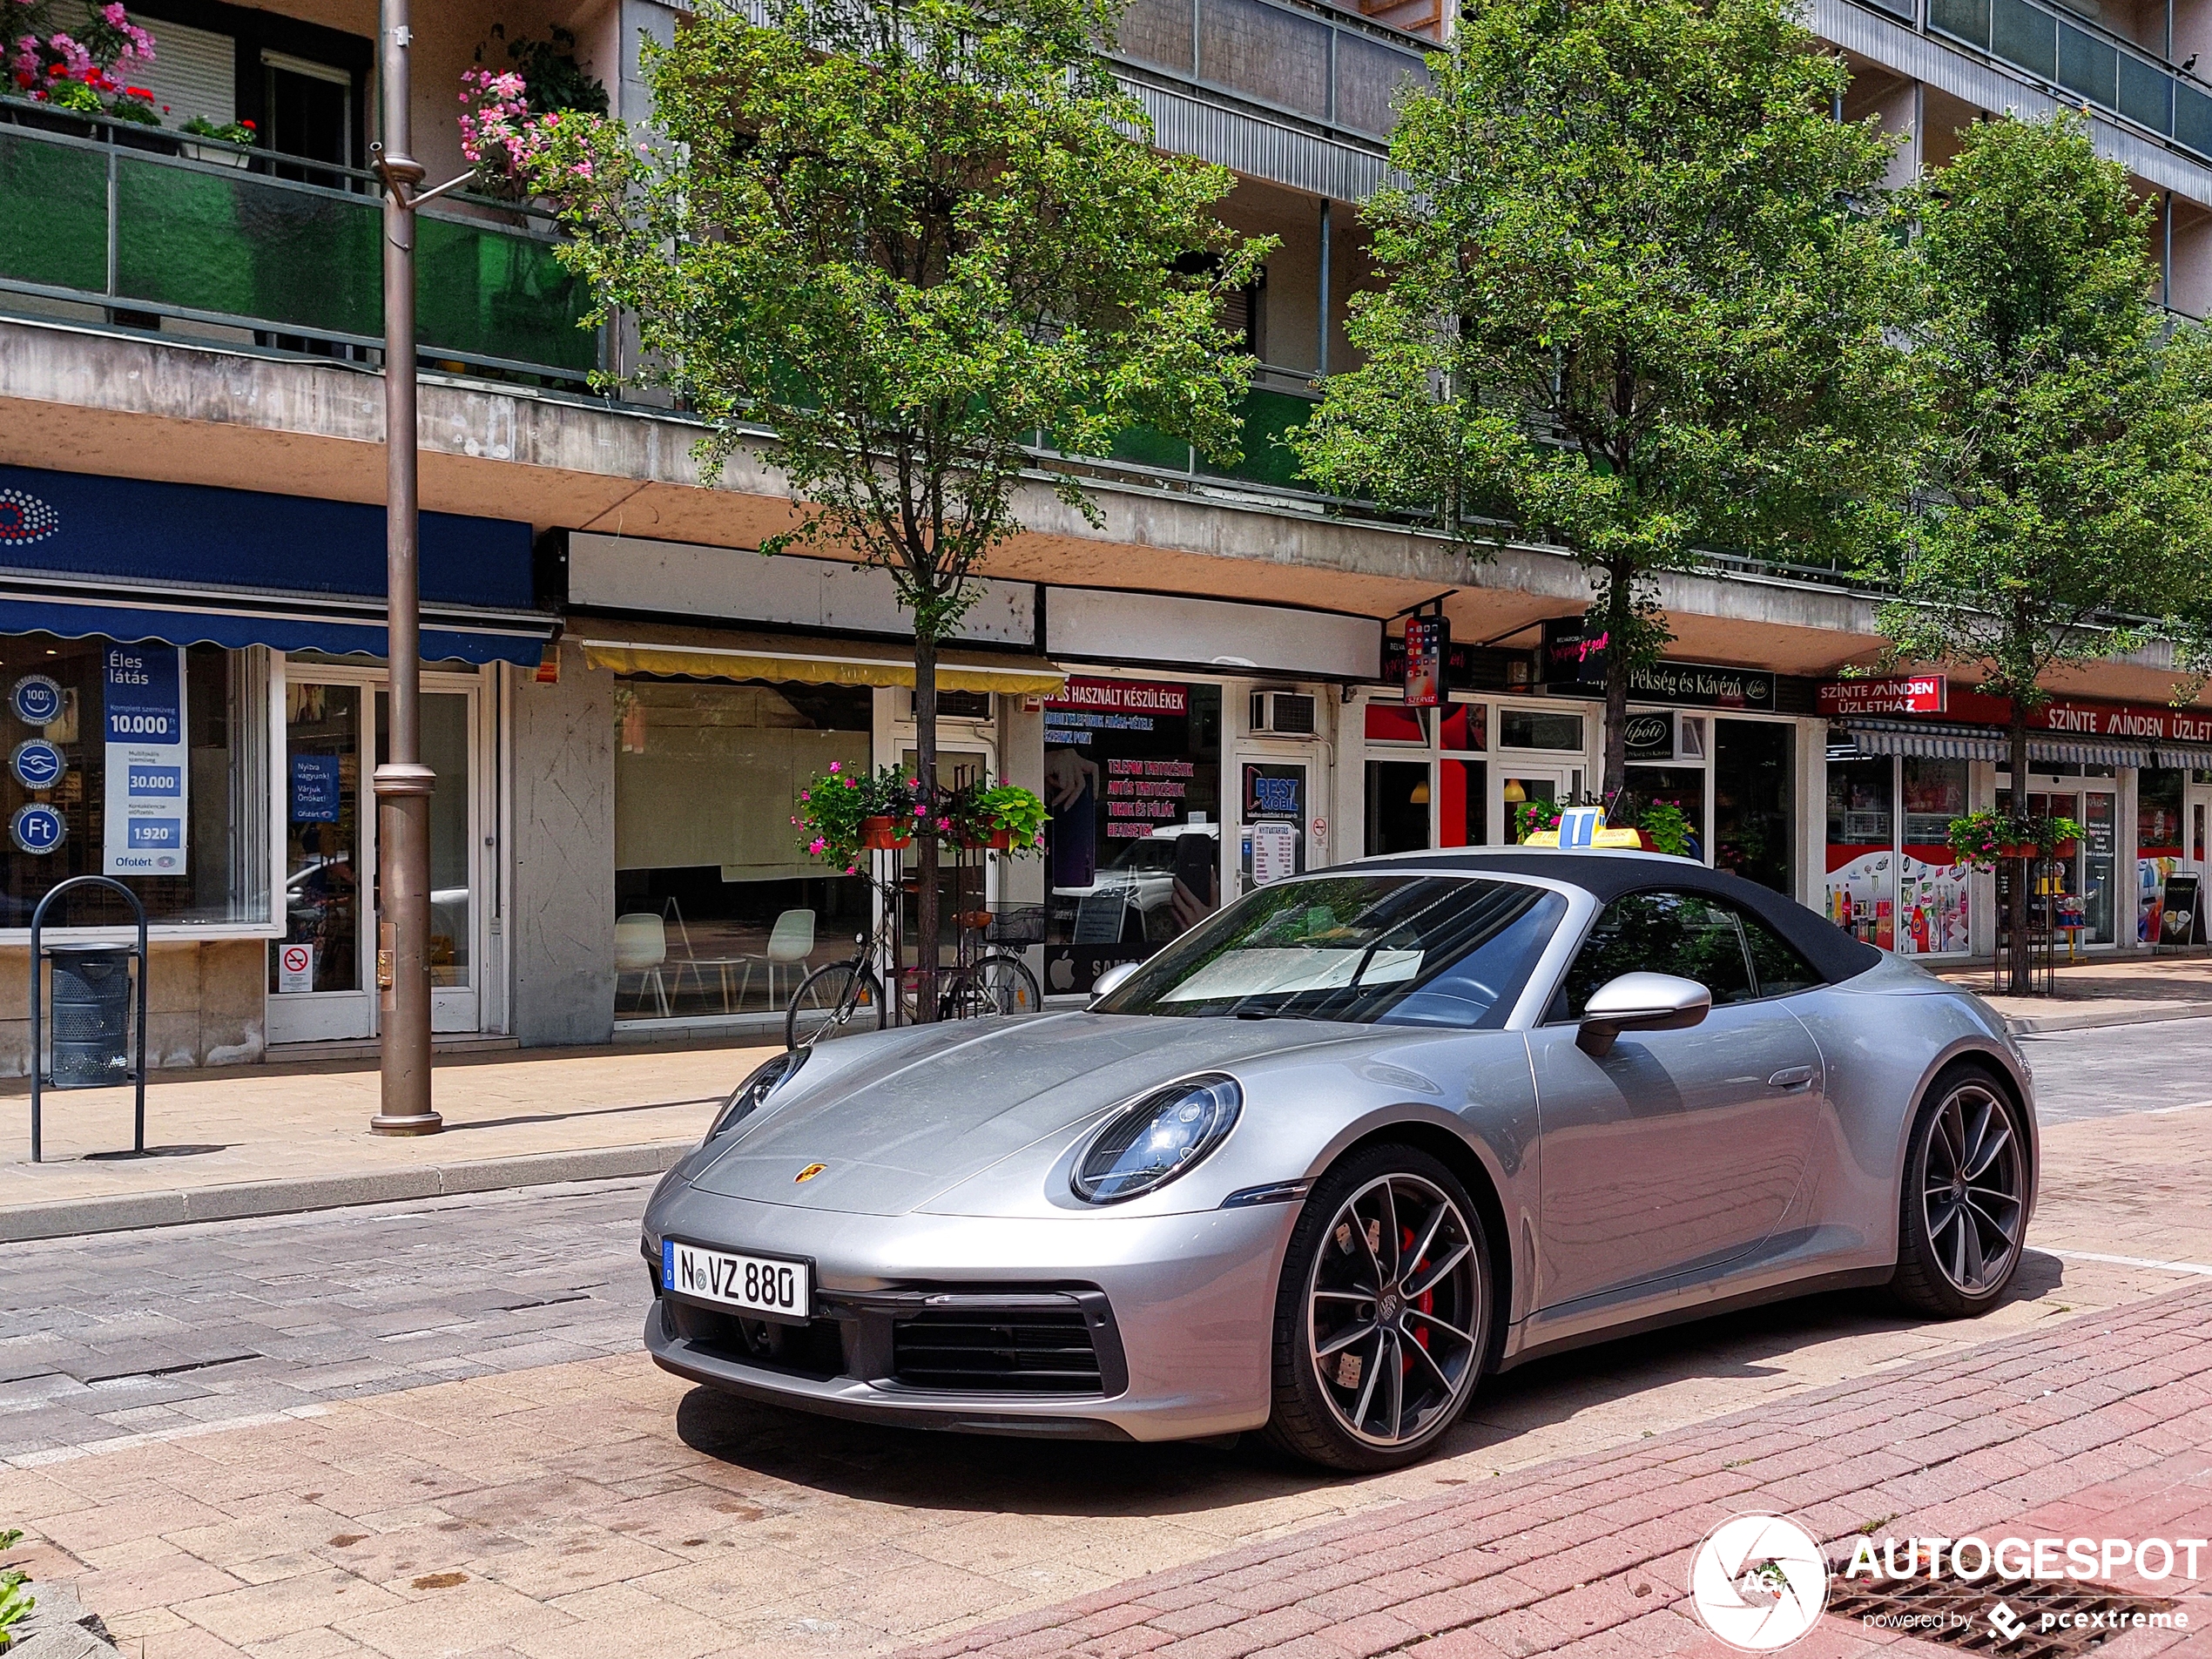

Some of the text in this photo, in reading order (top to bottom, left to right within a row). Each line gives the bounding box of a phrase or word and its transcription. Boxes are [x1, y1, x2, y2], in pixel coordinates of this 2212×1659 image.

[110, 650, 143, 669] Éles
[110, 669, 149, 685] látás
[1630, 667, 1676, 696] Pékség
[1679, 671, 1694, 693] és
[1697, 674, 1741, 697] Kávézó
[26, 690, 51, 701] 100%
[1072, 685, 1123, 706] HASZNÁLT
[1123, 688, 1184, 710] KÉSZÜLÉKEK
[142, 705, 175, 715] szemüveg
[1838, 697, 1915, 713] ÜZLETHÁZ
[111, 715, 168, 734] 10.000
[21, 738, 53, 748] INGYENES
[1074, 732, 1092, 745] PONT
[298, 763, 320, 772] Nyitva
[1108, 759, 1194, 777] TELEFON TARTOZÉKOK
[130, 775, 174, 789] 30.000
[298, 772, 329, 781] vagyunk!
[25, 781, 52, 790] SZERVIZ
[297, 785, 321, 795] Várjuk
[1107, 779, 1186, 798] AUTÓS TARTOZÉKOK
[1256, 778, 1298, 798] BEST
[298, 793, 326, 802] Önöket!
[1261, 796, 1298, 812] MOBIL
[1107, 799, 1176, 817] TOKOK ÉS FÓLIÁK
[29, 818, 51, 840] Ft
[134, 827, 169, 840] 1.920
[116, 857, 152, 867] Ofotért
[681, 1250, 794, 1308] N VZ 880
